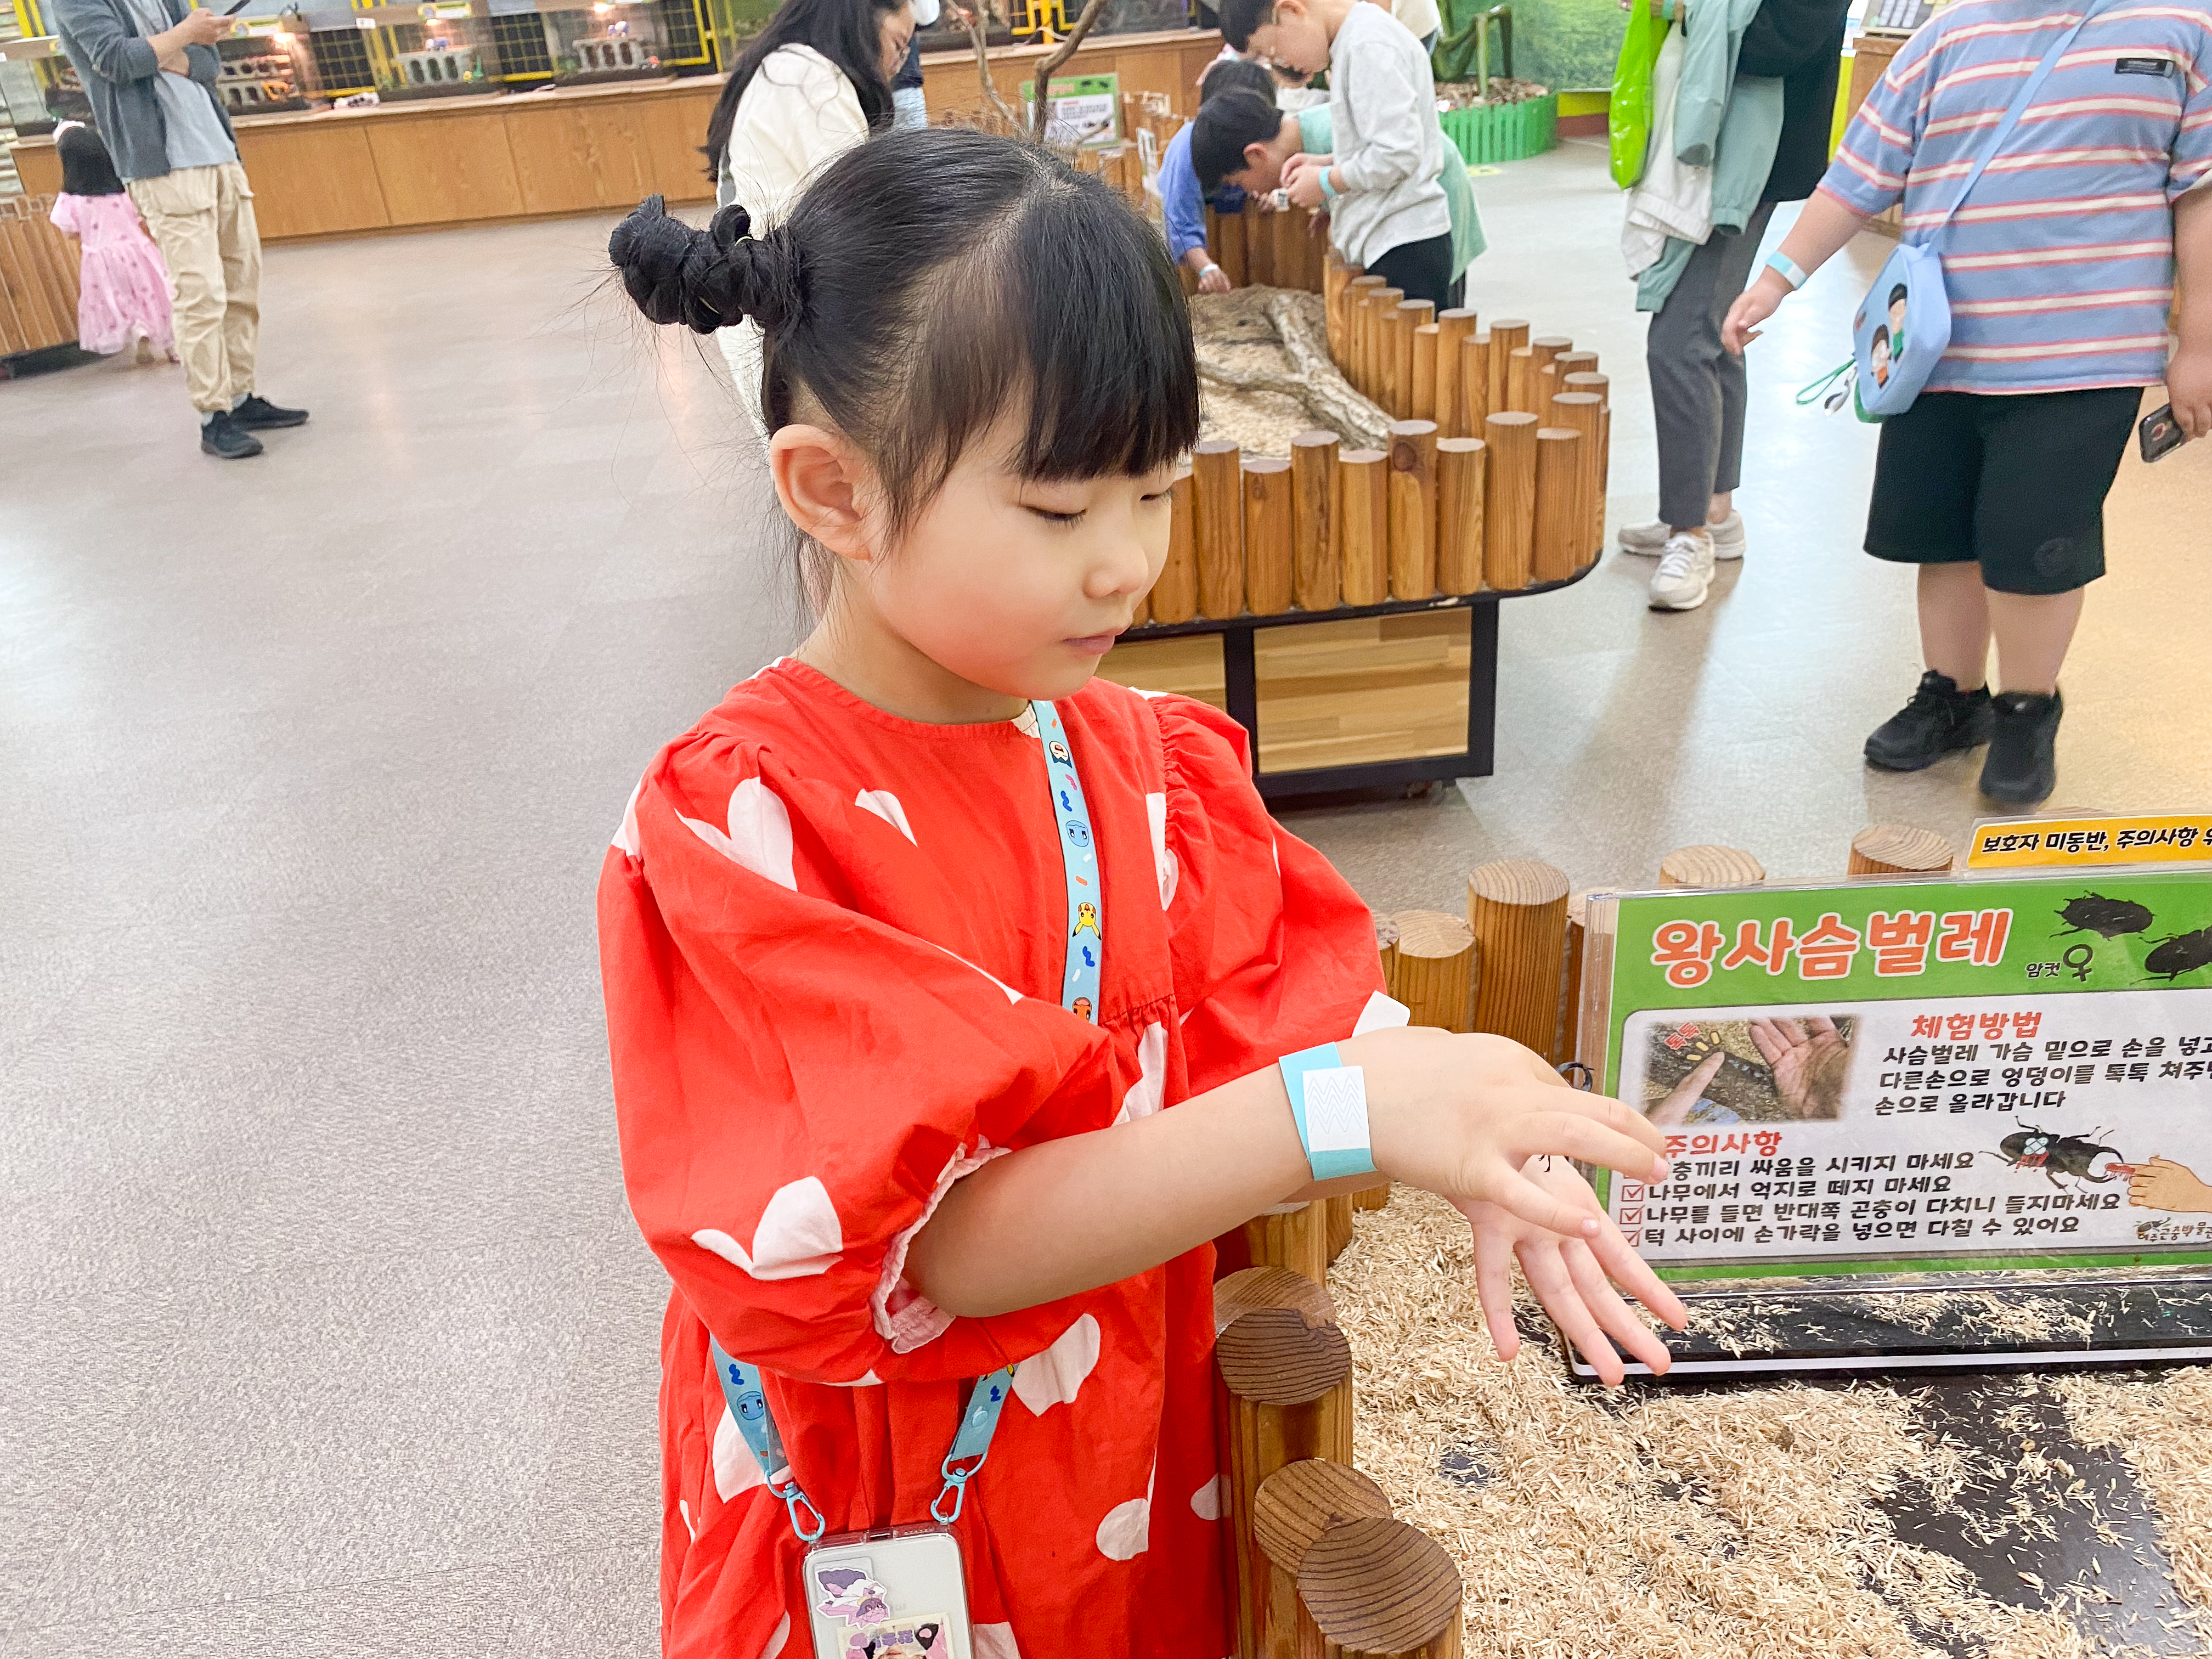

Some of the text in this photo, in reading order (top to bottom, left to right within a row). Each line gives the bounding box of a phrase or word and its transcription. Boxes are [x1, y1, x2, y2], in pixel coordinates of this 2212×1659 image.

[1982, 833, 2040, 853] 보호자
[2045, 831, 2109, 853] 미동반,
[2117, 826, 2199, 849] 주의사항
[1651, 909, 2013, 988] 왕사슴벌레
[2026, 962, 2061, 978] 암컷
[1911, 1012, 2042, 1041] 체험방법
[1882, 1045, 1978, 1065] 사슴벌레
[1989, 1042, 2033, 1062] 가슴
[2045, 1040, 2113, 1060] 밑으로
[2121, 1037, 2166, 1058] 손을
[1880, 1060, 2212, 1090] 다른손으로 엉덩이를 톡톡 쳐주
[1875, 1091, 2067, 1115] 손으로 올라갑니다
[1664, 1131, 1782, 1158] 주의사항
[1668, 1152, 1974, 1181] 충끼리 싸움을 시키지 마세요
[1649, 1176, 1951, 1201] 나무에서 억지로 떼지 마세요
[1647, 1193, 2120, 1223] 나무를 들면 반대쪽 곤충이 다치니 들지마세요
[1645, 1216, 2079, 1246] 턱 사이에 손가락을 넣으면 다칠 수 있어요
